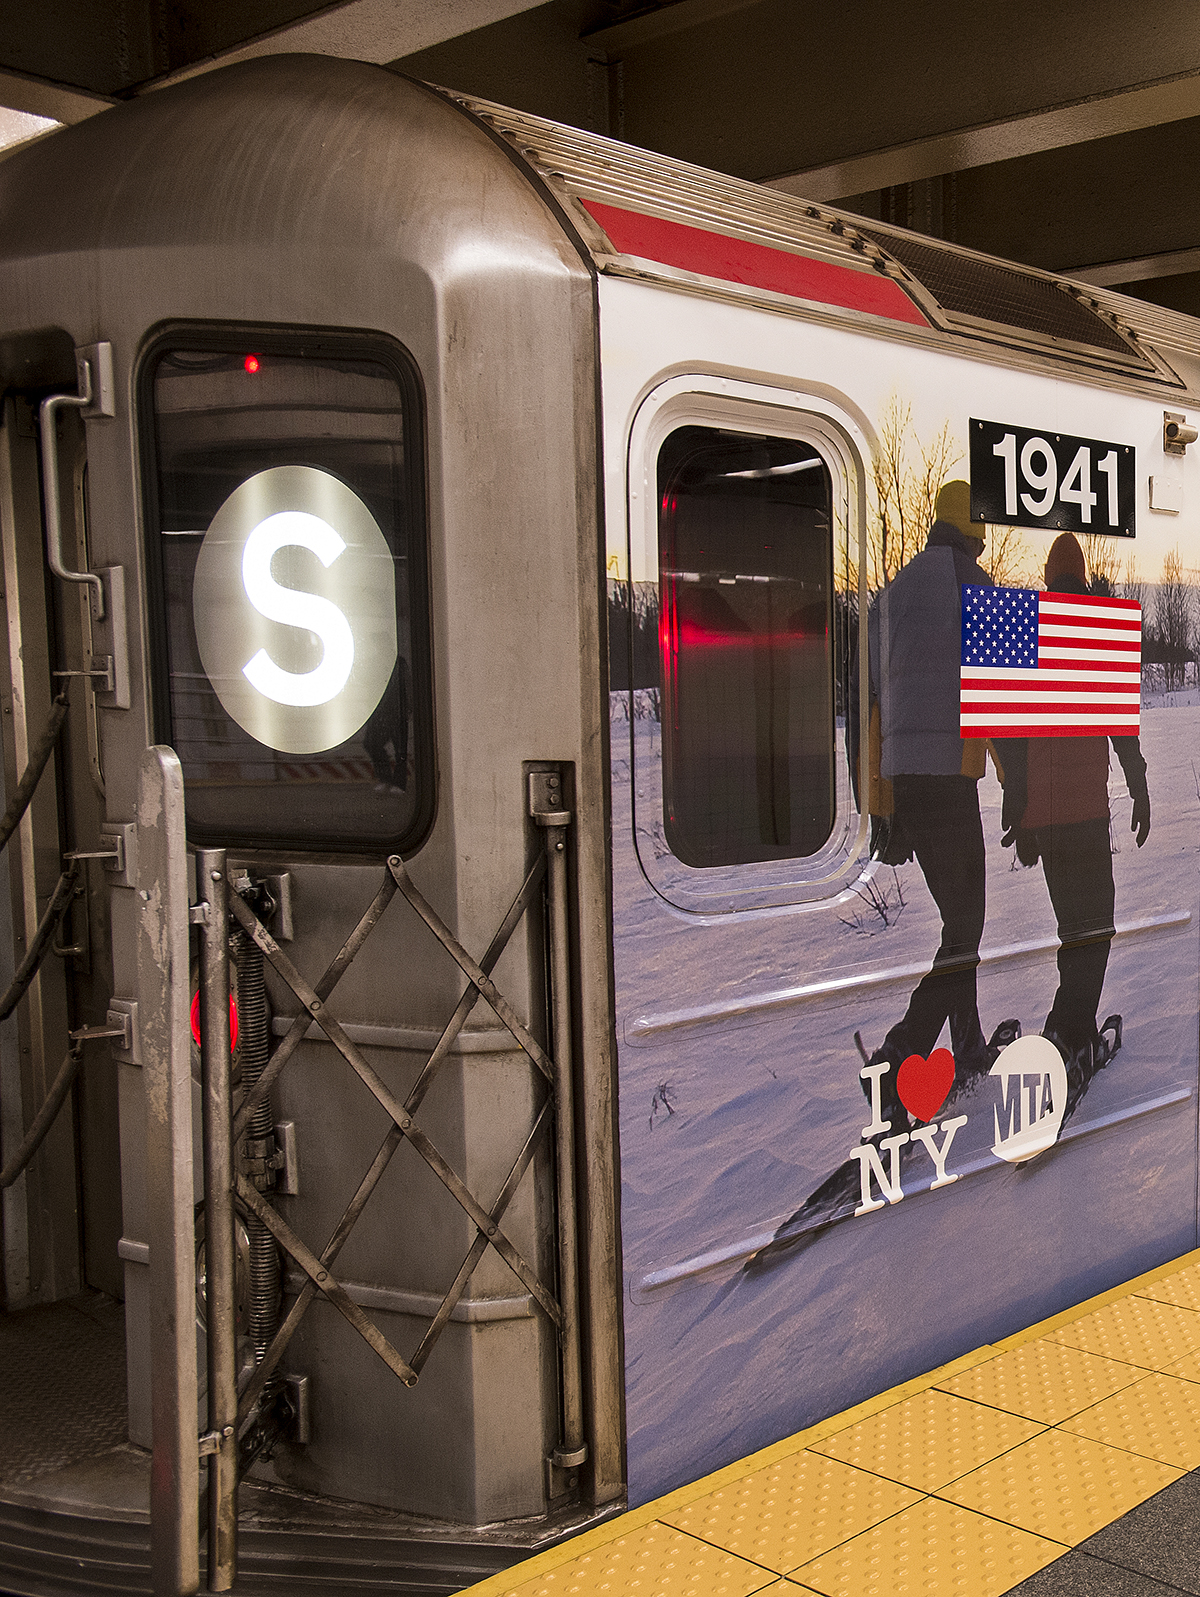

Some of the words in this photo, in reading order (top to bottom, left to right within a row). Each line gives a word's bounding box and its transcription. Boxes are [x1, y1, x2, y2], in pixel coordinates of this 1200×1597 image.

[992, 433, 1120, 527] 1941
[241, 510, 355, 708] S
[860, 1061, 892, 1138] I
[849, 1114, 968, 1217] NY
